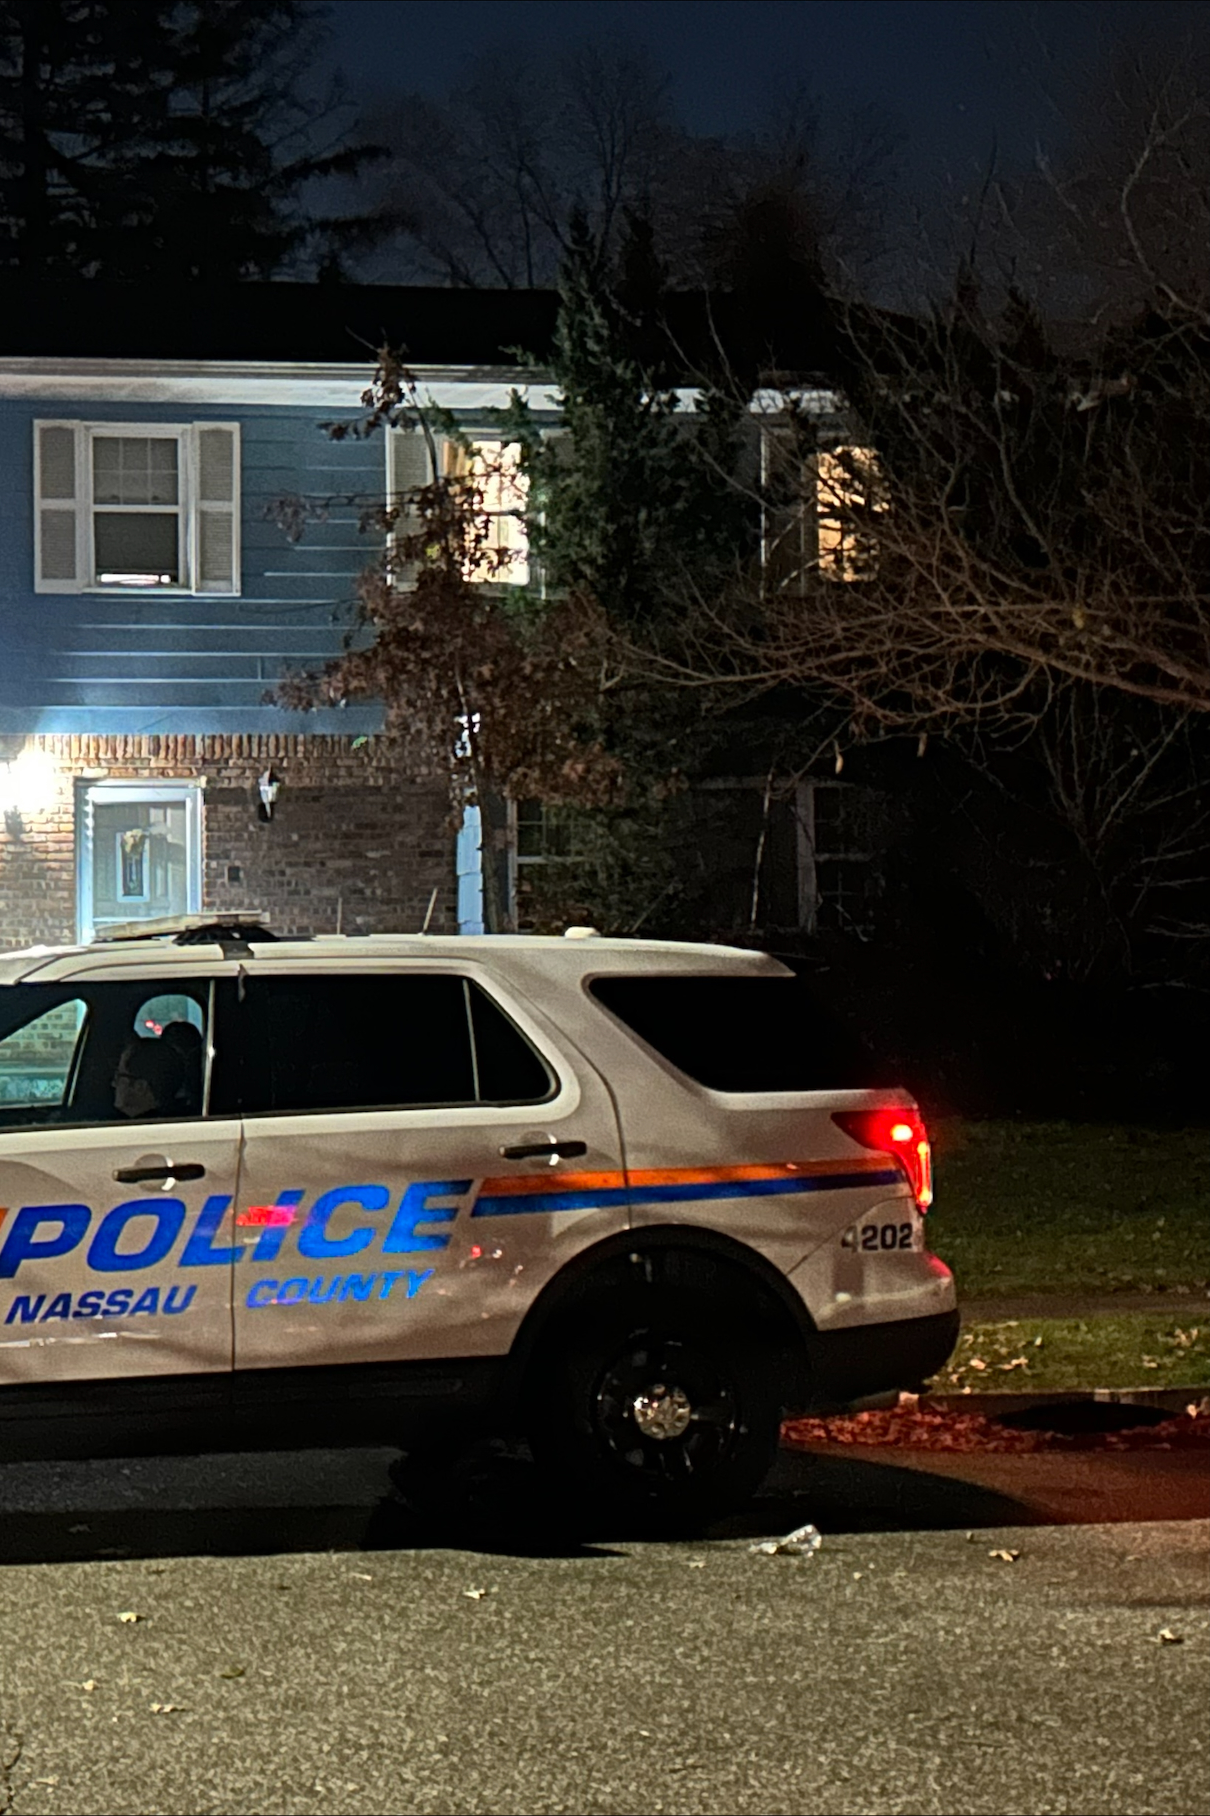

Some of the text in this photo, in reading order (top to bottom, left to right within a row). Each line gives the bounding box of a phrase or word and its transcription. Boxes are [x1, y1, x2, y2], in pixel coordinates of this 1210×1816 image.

[841, 1223, 912, 1251] 4202
[4, 1268, 436, 1324] NASSAU COUNTY
